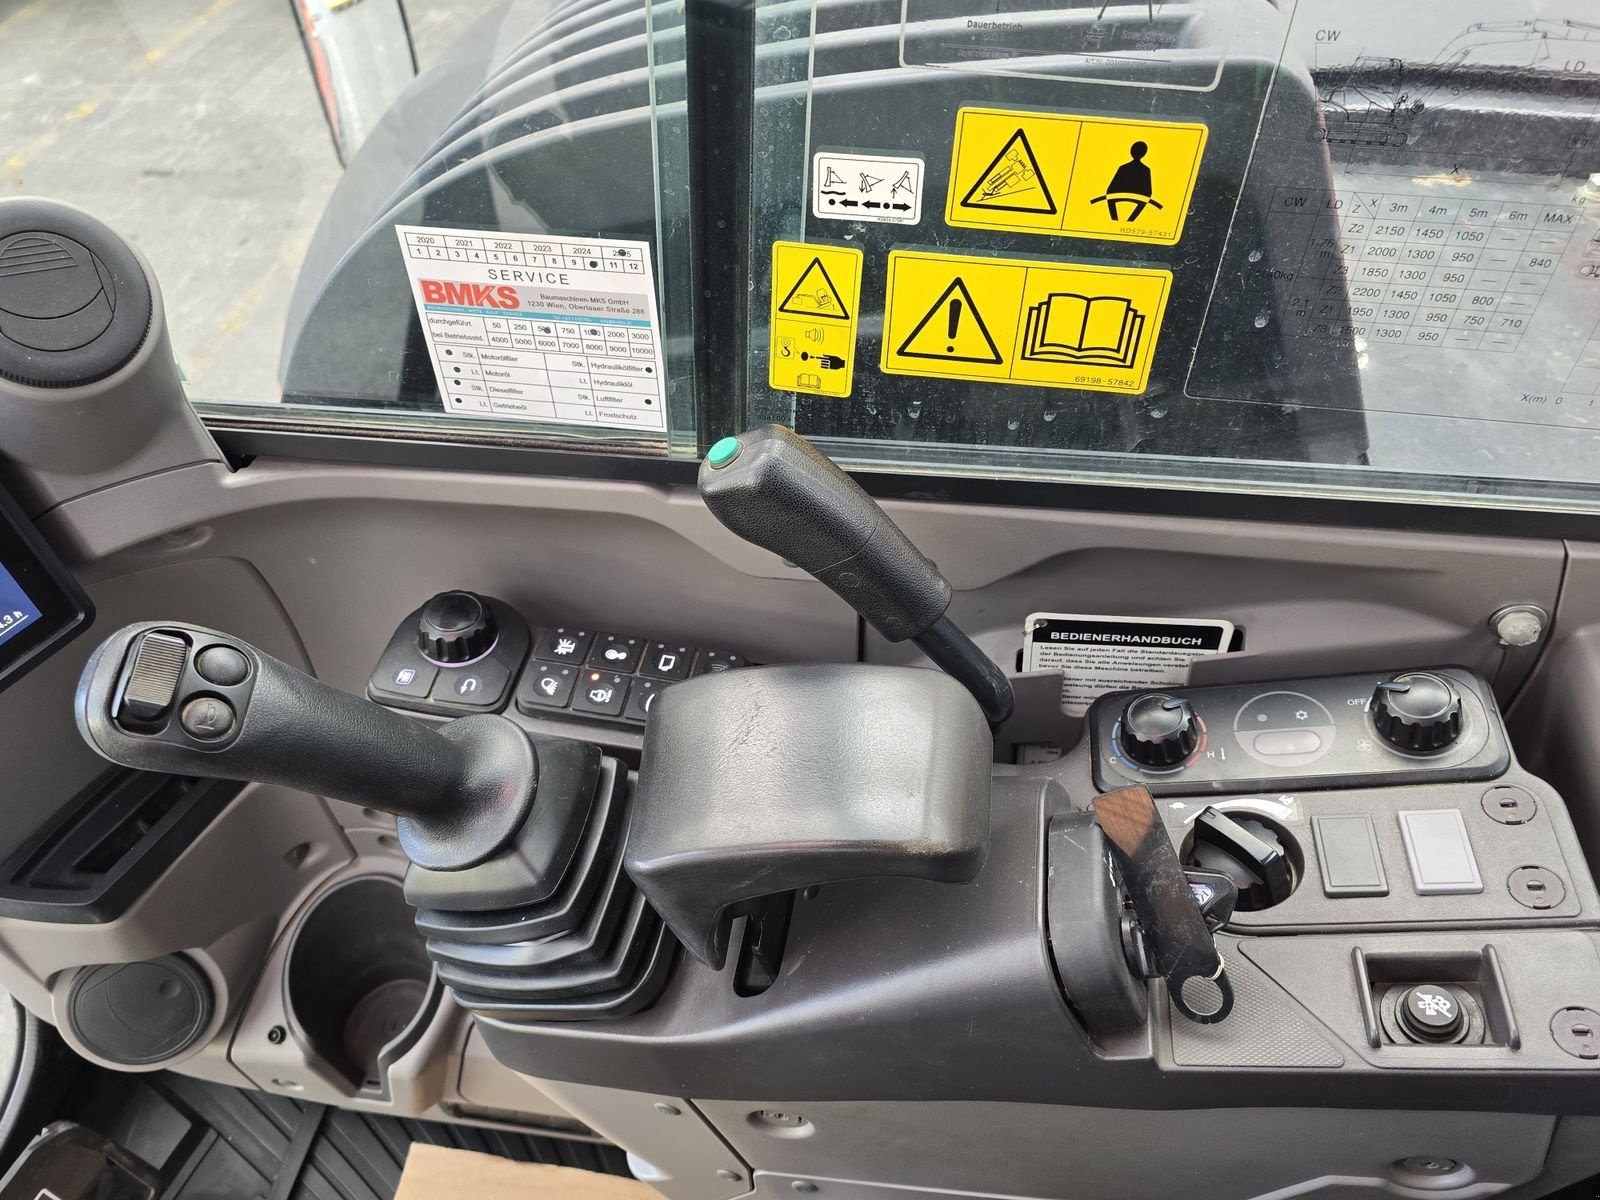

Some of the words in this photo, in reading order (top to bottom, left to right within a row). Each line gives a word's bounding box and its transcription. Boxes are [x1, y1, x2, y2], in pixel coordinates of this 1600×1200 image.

[967, 20, 1023, 31] Dauerbetrieb
[1315, 29, 1341, 42] CW
[1563, 60, 1586, 72] LD
[1450, 164, 1462, 175] X
[1571, 194, 1586, 206] kg
[1284, 197, 1307, 207] CW
[1326, 200, 1343, 209] LD
[1352, 205, 1361, 214] Z
[1369, 198, 1378, 207] X
[1389, 203, 1408, 213] 3m
[1428, 205, 1448, 215] 4m
[1469, 208, 1488, 218] 5m
[1508, 211, 1528, 221] 6m
[1544, 213, 1575, 224] MAX
[1348, 224, 1365, 233] Z2
[1375, 226, 1405, 236] 2150
[1416, 229, 1444, 239] 1450
[1455, 231, 1484, 242] 1050
[416, 236, 435, 244] 2020
[455, 239, 473, 247] 2021
[494, 242, 512, 250] 2022
[533, 244, 552, 252] 2023
[573, 247, 591, 255] 2024
[1341, 245, 1355, 254] Z1
[1368, 247, 1397, 257] 2000
[1407, 250, 1435, 260] 1300
[1451, 253, 1474, 263] 950
[1529, 258, 1551, 268] 840
[488, 269, 570, 285] SERVICE
[1334, 265, 1349, 275] Z3
[1362, 268, 1388, 278] 1850
[1400, 270, 1426, 280] 1300
[1443, 273, 1465, 283] 950
[421, 280, 520, 310] BMKS
[540, 293, 607, 304] Baumaschinen-MKS
[1327, 286, 1341, 295] Z2
[1352, 288, 1381, 298] 2200
[1391, 290, 1418, 300] 1450
[1430, 293, 1457, 303] 1050
[1472, 296, 1494, 306] 800
[546, 302, 567, 310] Wien,
[429, 317, 472, 327] durchgeführt
[1320, 305, 1333, 313] Z1
[1348, 307, 1373, 317] 1950
[1383, 310, 1410, 320] 1300
[1426, 313, 1448, 323] 950
[1464, 316, 1485, 326] 750
[1501, 319, 1523, 328] 710
[445, 333, 483, 341] Betriebsstd.
[1313, 324, 1327, 333] Z3
[1340, 326, 1366, 336] 1500
[1375, 329, 1402, 338] 1300
[1418, 332, 1439, 341] 950
[591, 362, 643, 372] Hydraulikölfilter
[1075, 376, 1134, 387] 69198-57842
[489, 386, 523, 394] Dieselfilter
[596, 395, 623, 403] Luftfilter
[1520, 393, 1547, 405] X(m)
[1555, 396, 1564, 405] 0
[493, 402, 527, 410] Getriebeöl
[599, 412, 637, 420] Frostschutz
[13, 610, 23, 619] h
[1050, 632, 1202, 646] BEDIENERHANDBUCH
[1054, 652, 1129, 660] Bedienungsanleitung
[1347, 698, 1366, 706] OFF
